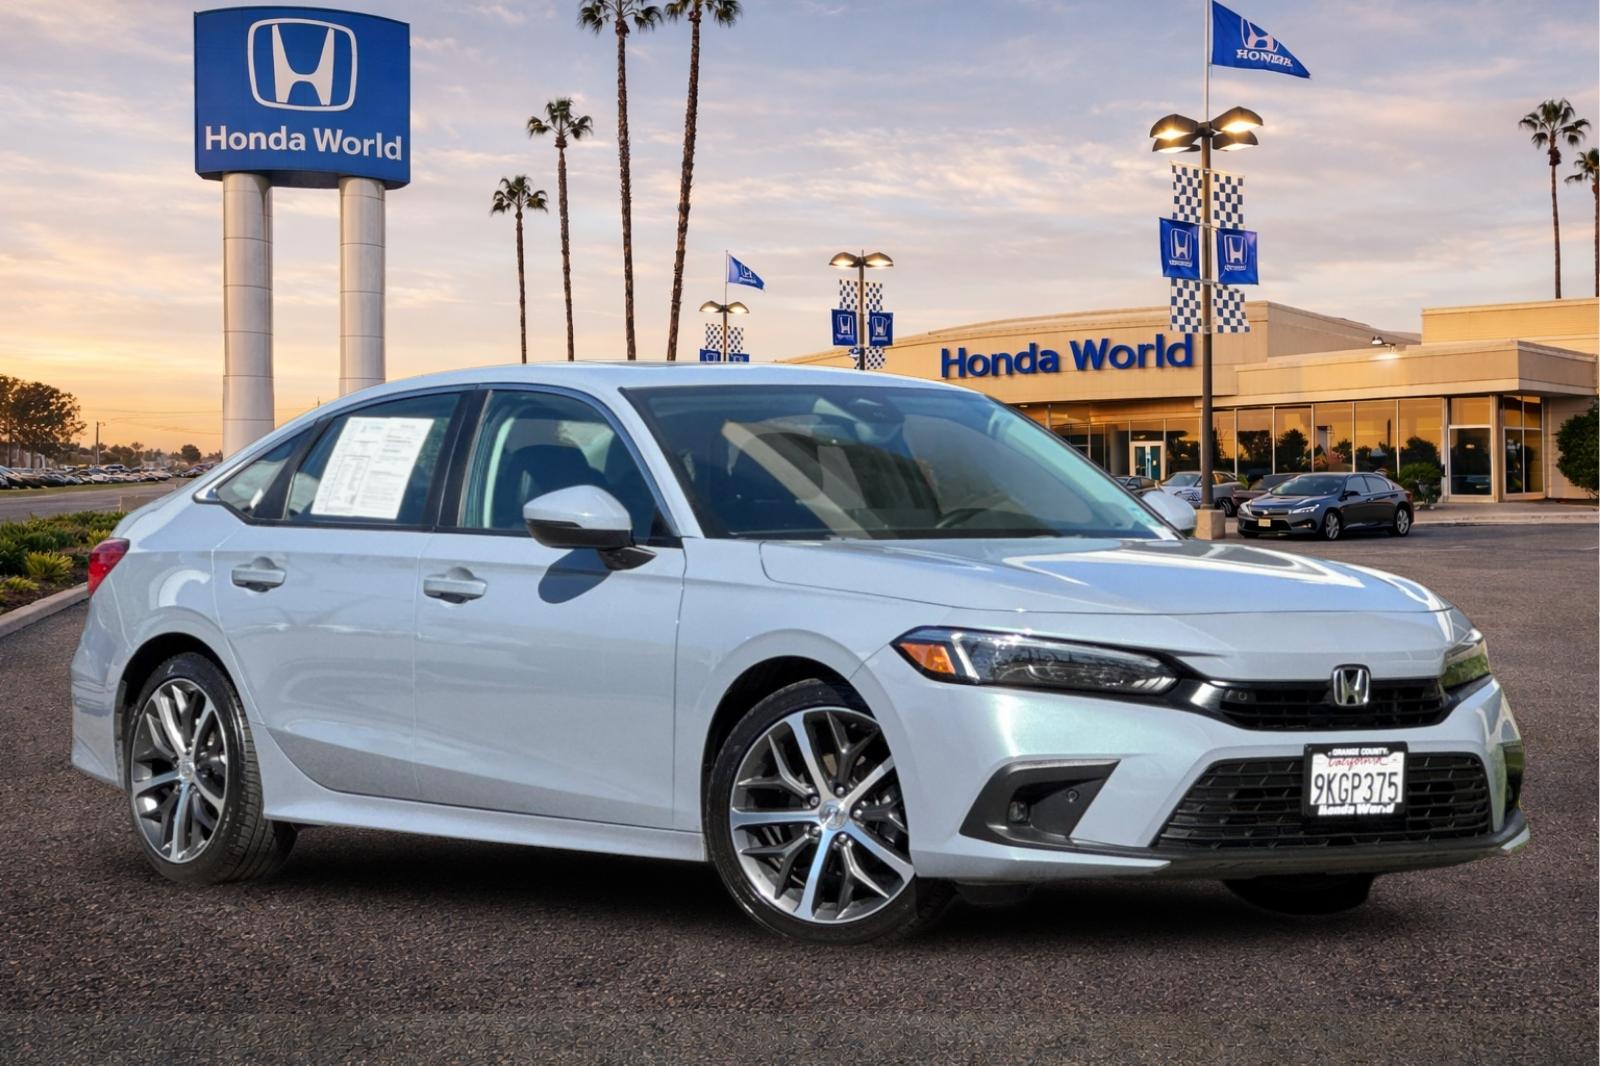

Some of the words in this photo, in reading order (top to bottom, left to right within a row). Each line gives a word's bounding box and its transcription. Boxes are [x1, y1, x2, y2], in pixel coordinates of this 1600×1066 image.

[205, 125, 306, 151] Honda
[313, 127, 402, 161] World
[941, 342, 1061, 379] Honda
[1070, 333, 1194, 371] World
[1313, 772, 1398, 805] 9KGP375
[1318, 803, 1356, 816] Honda
